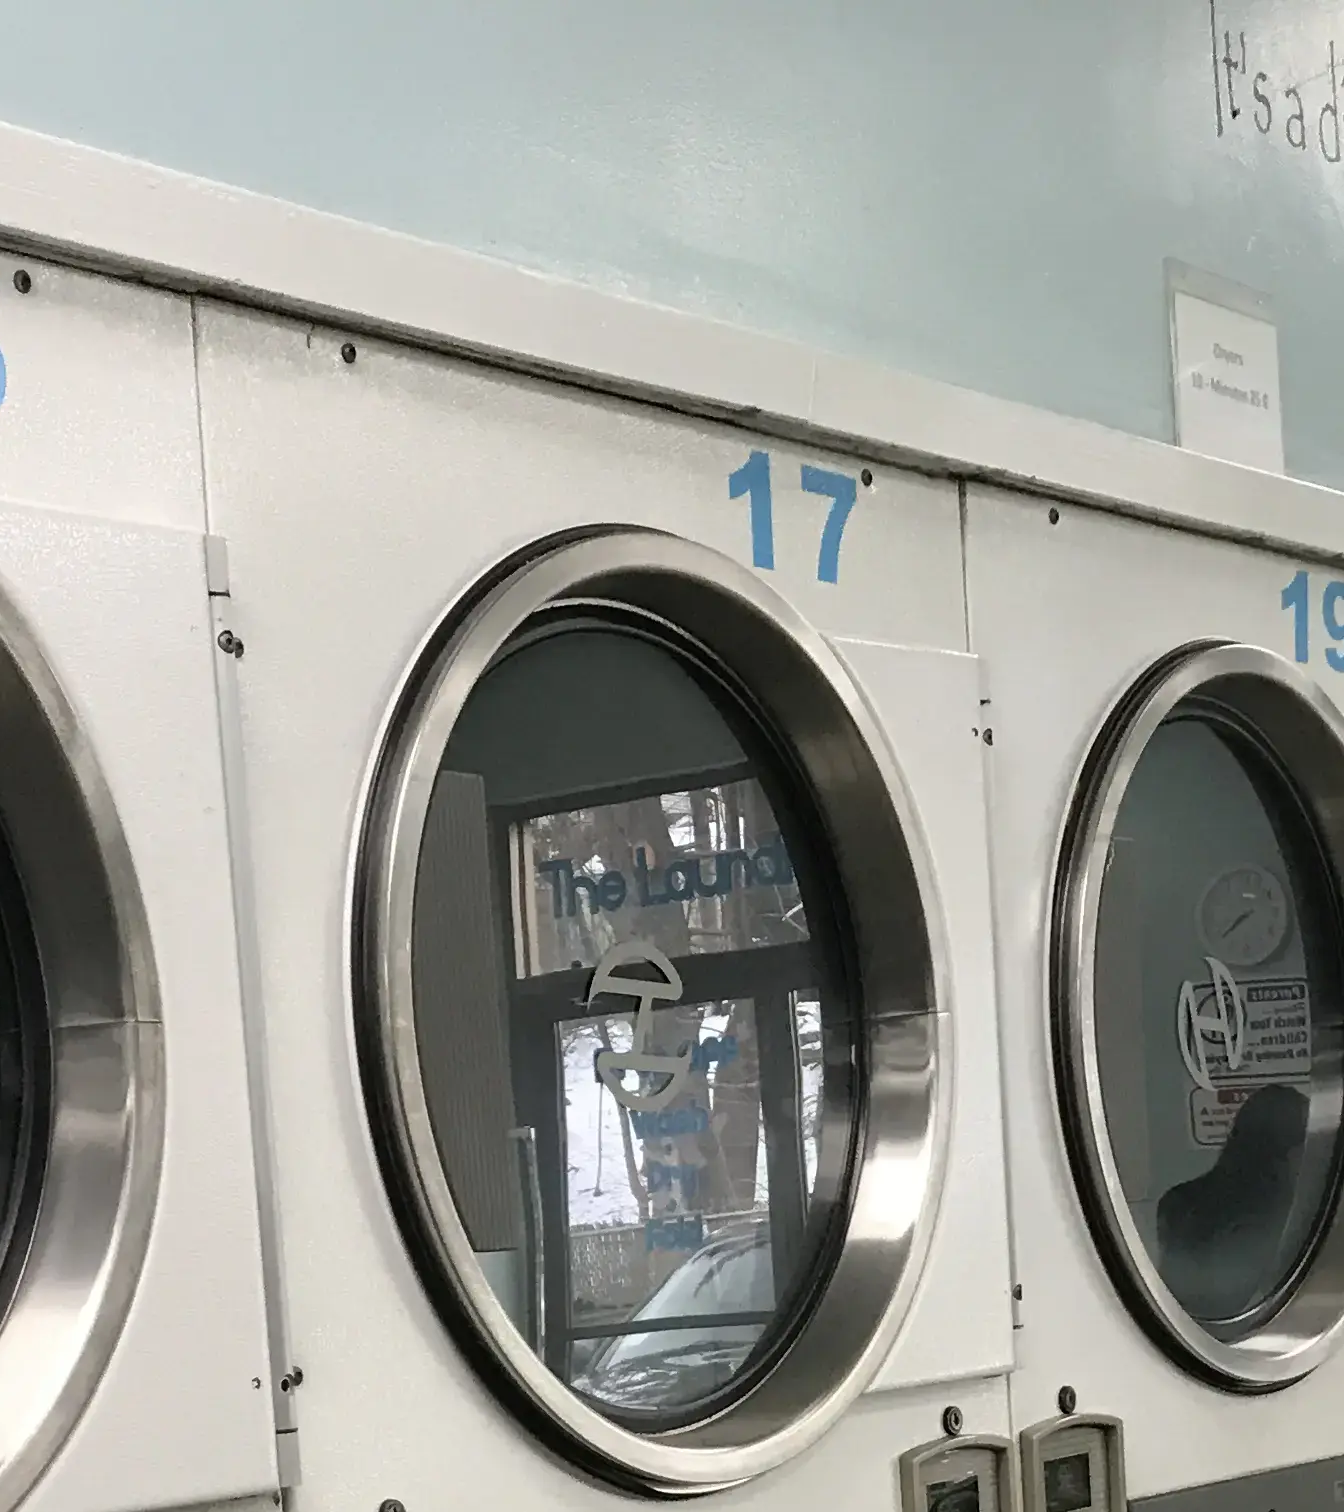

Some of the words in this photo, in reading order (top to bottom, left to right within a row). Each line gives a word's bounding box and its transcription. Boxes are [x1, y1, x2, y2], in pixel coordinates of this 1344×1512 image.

[1210, 0, 1269, 138] It's
[1285, 86, 1307, 150] a
[728, 451, 857, 585] 17
[539, 858, 627, 917] The
